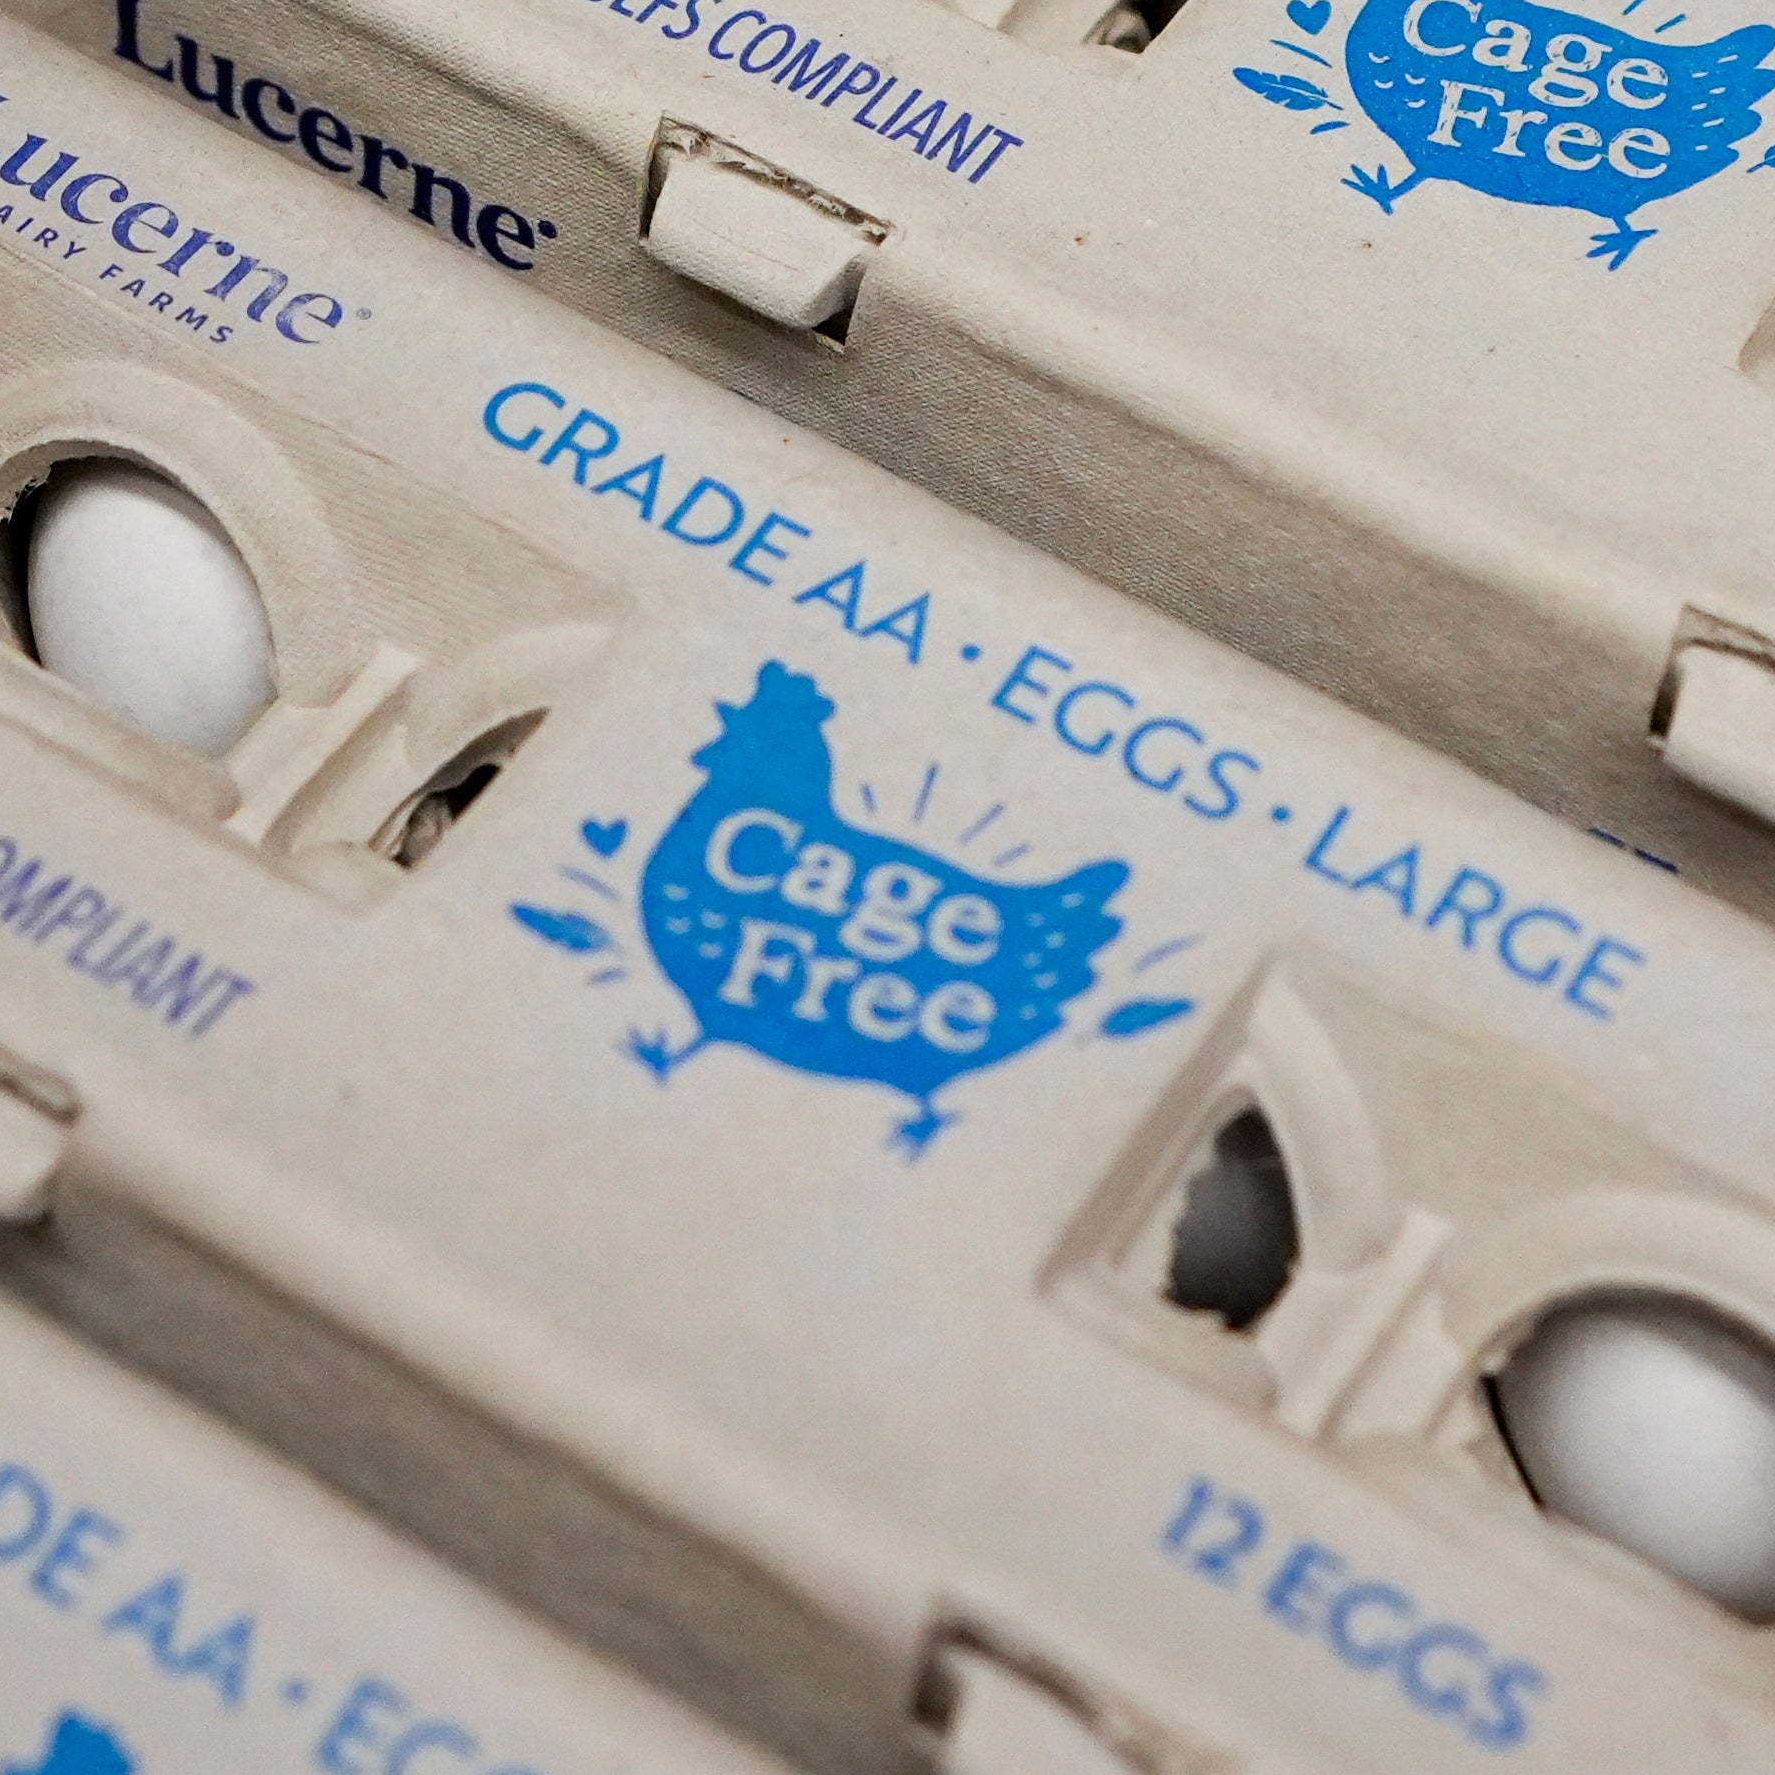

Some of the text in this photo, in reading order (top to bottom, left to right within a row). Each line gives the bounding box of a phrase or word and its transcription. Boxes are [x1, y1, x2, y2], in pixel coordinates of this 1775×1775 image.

[704, 7, 1025, 187] COMPLIANT
[1425, 78, 1672, 180] Free
[98, 262, 237, 345] FARMS
[481, 379, 1648, 1025] GRADE AA EGGS LARGE
[703, 806, 1004, 969] Cage
[723, 918, 999, 1057] Free
[101, 1566, 262, 1708] AA
[1157, 1474, 1555, 1753] 12 EGGS
